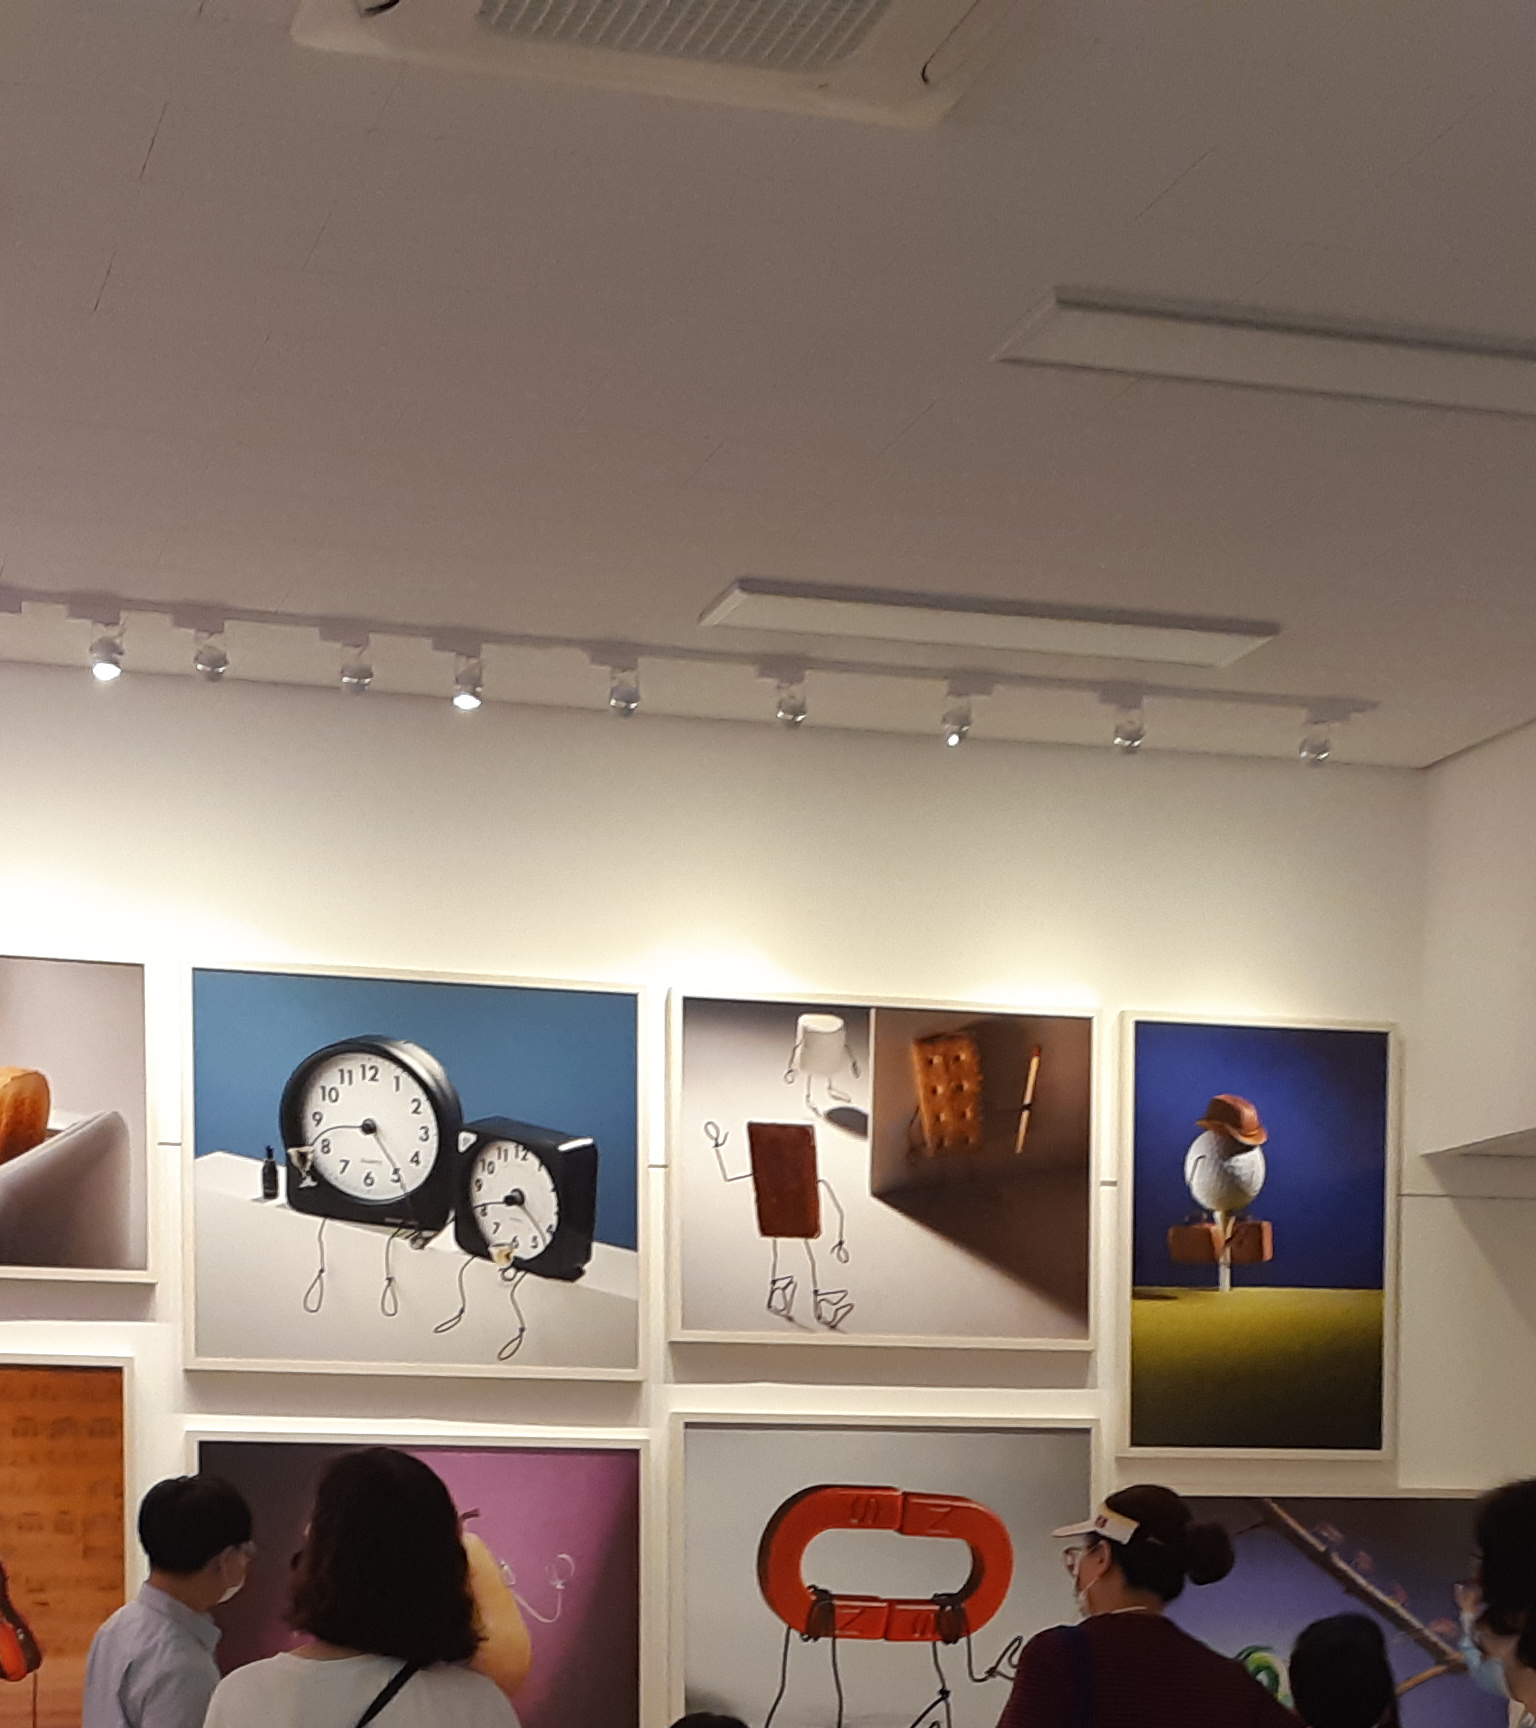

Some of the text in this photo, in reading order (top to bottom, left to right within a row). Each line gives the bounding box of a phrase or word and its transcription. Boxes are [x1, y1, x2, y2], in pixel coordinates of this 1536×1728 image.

[338, 1068, 353, 1086] 11
[360, 1064, 379, 1081] 12
[393, 1075, 400, 1092] 1
[320, 1085, 339, 1103] 10
[411, 1098, 422, 1115] 2
[312, 1111, 323, 1127] 9
[419, 1126, 429, 1142] 3
[321, 1138, 331, 1154] 8
[496, 1146, 508, 1162] 11
[409, 1151, 420, 1166] 4
[480, 1158, 495, 1175] 10
[339, 1159, 350, 1175] 7
[363, 1171, 375, 1187] 6
[475, 1178, 482, 1192] 9
[492, 1221, 501, 1235] 7
